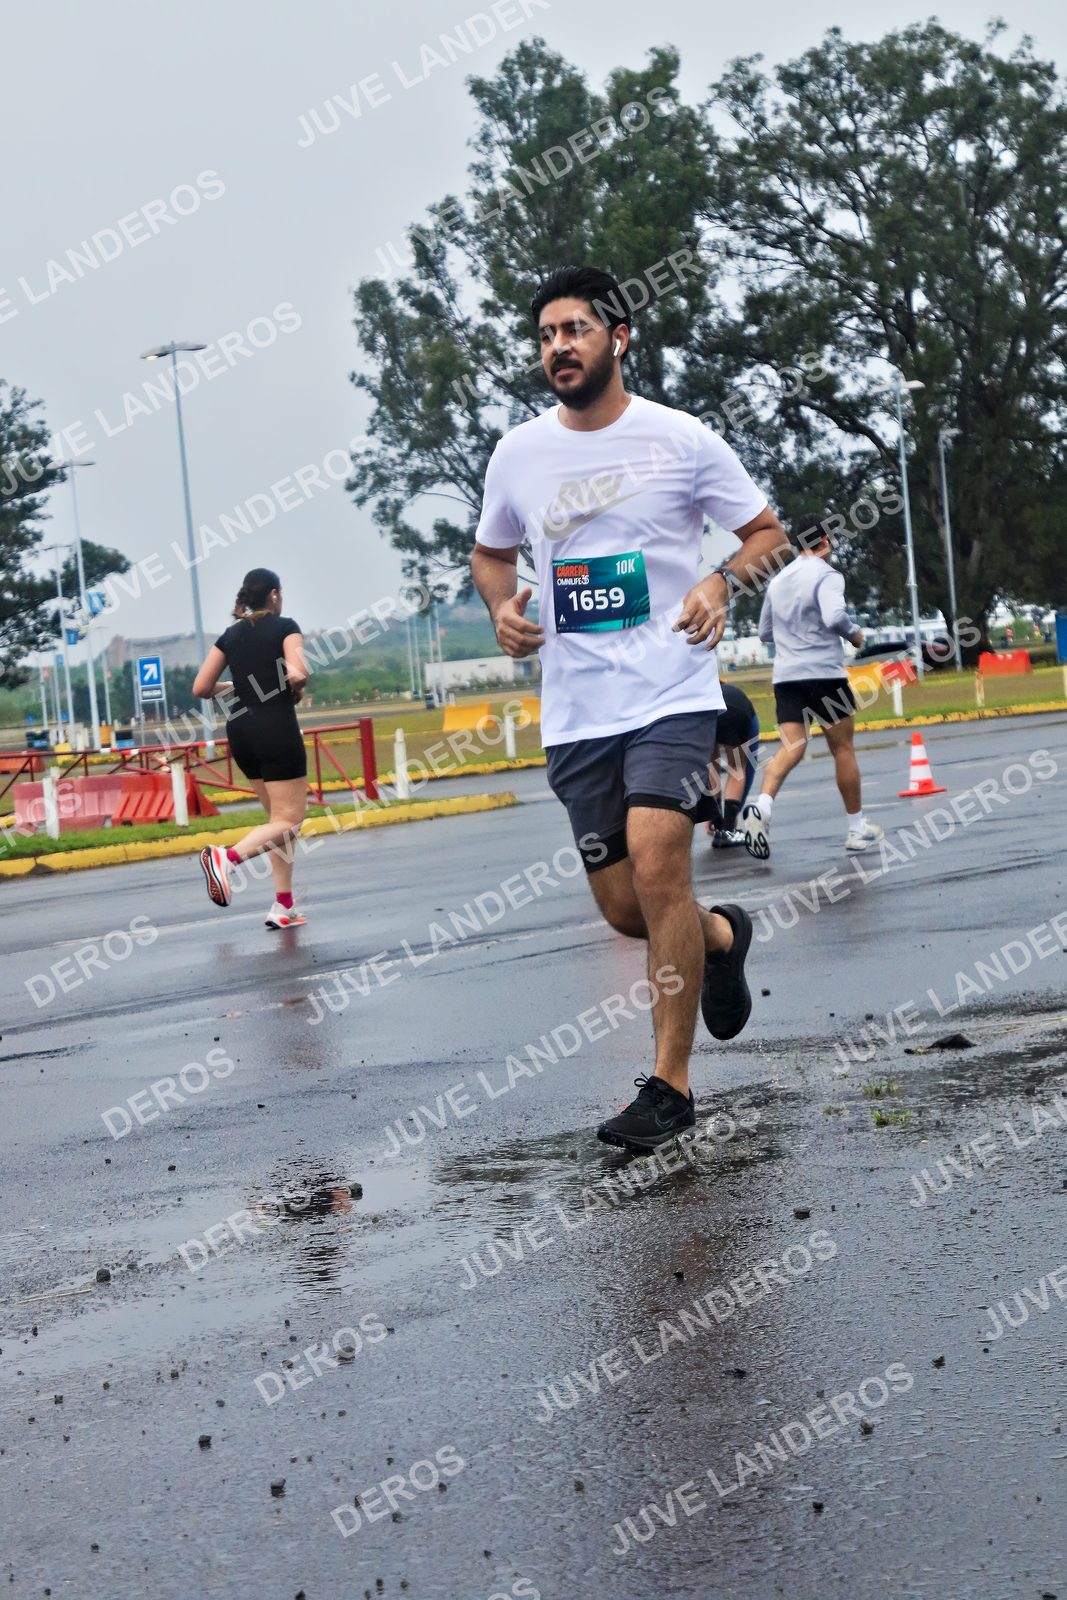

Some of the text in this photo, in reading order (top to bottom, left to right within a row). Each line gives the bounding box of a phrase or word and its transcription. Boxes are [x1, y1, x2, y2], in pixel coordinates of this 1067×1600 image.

[557, 565, 588, 578] CARRERA
[616, 558, 635, 575] 10K
[568, 587, 625, 611] 1659
